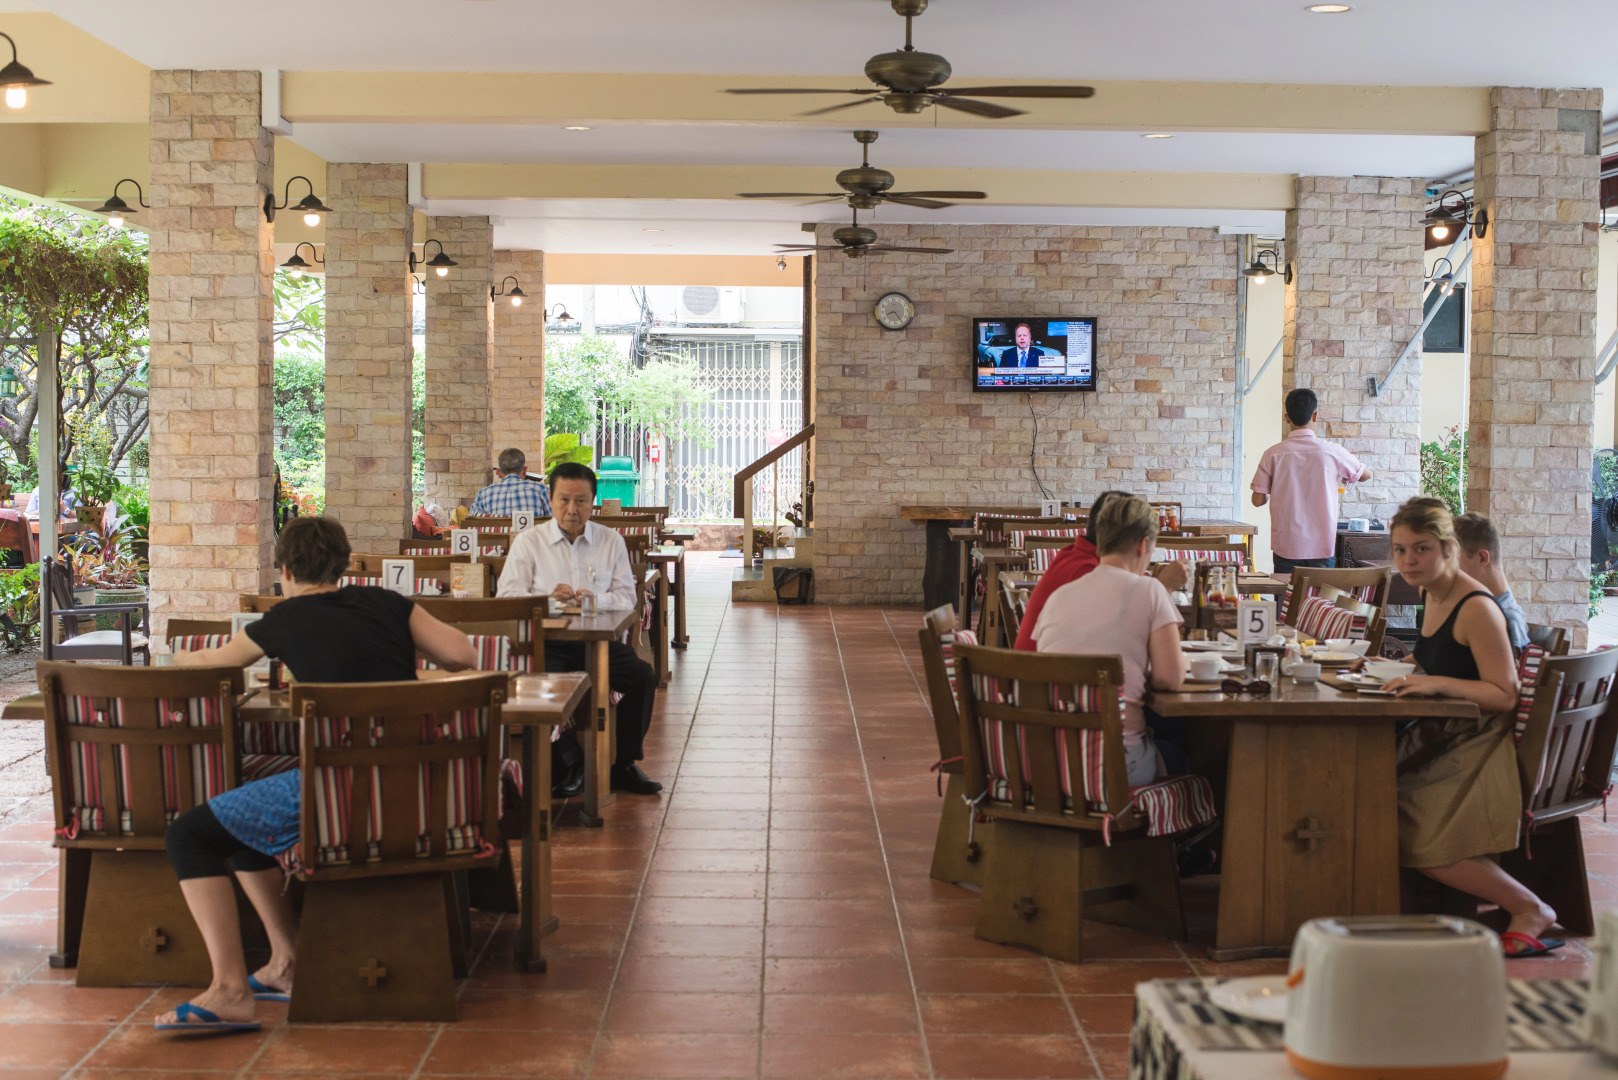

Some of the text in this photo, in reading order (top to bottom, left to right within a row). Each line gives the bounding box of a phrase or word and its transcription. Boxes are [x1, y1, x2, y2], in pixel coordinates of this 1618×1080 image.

[1047, 504, 1054, 516] 1
[518, 516, 528, 530] 9
[459, 535, 470, 551] 8
[391, 565, 405, 585] 7
[1248, 610, 1265, 634] 5
